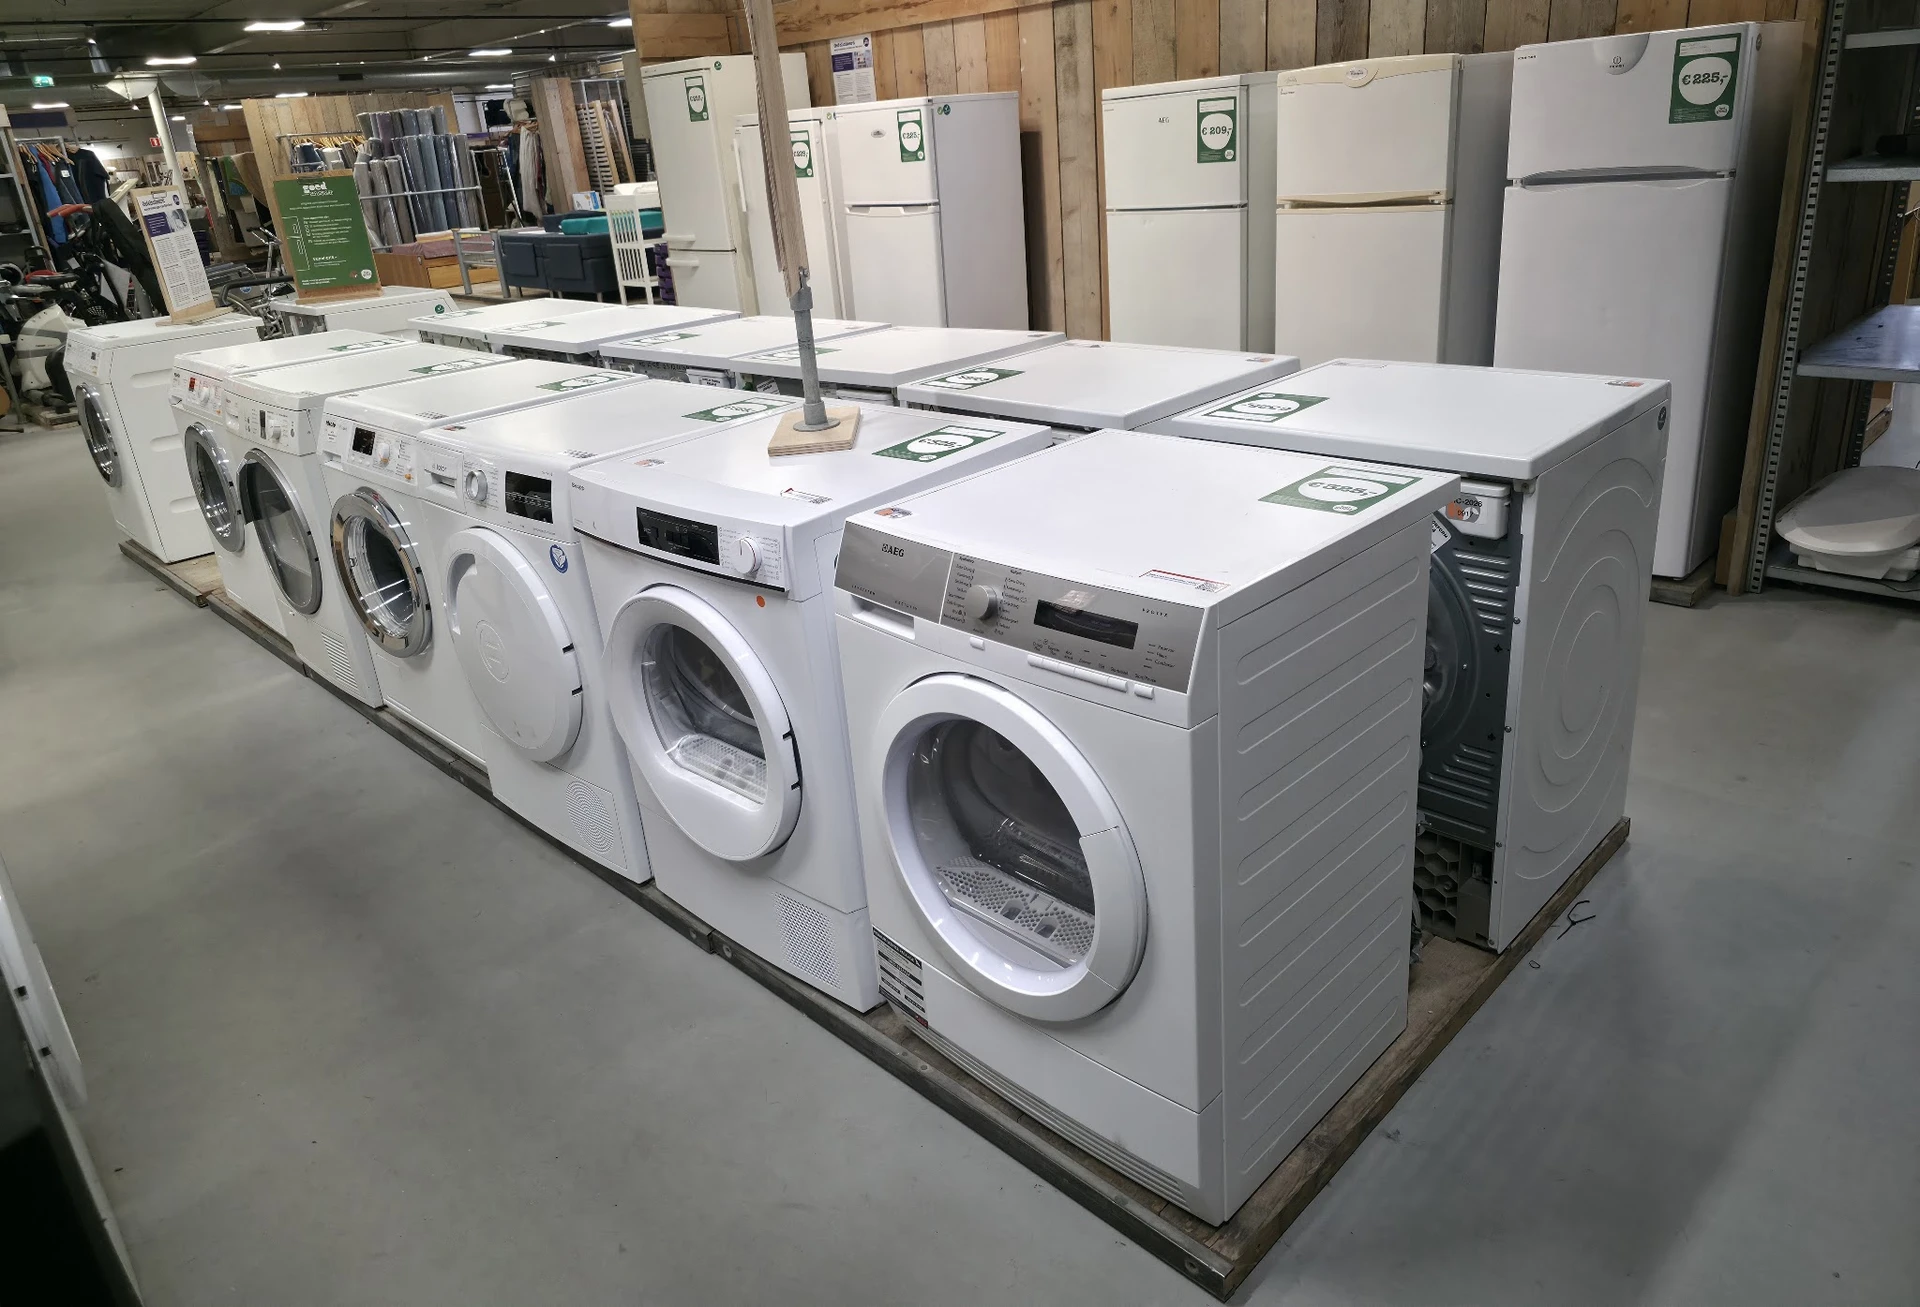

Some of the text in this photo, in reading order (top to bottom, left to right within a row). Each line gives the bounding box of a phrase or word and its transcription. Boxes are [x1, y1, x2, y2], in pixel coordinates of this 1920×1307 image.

[1692, 72, 1728, 85] 225,-
[1201, 126, 1232, 137] € 209,-
[1453, 498, 1483, 507] C-2026
[887, 545, 905, 558] AEG
